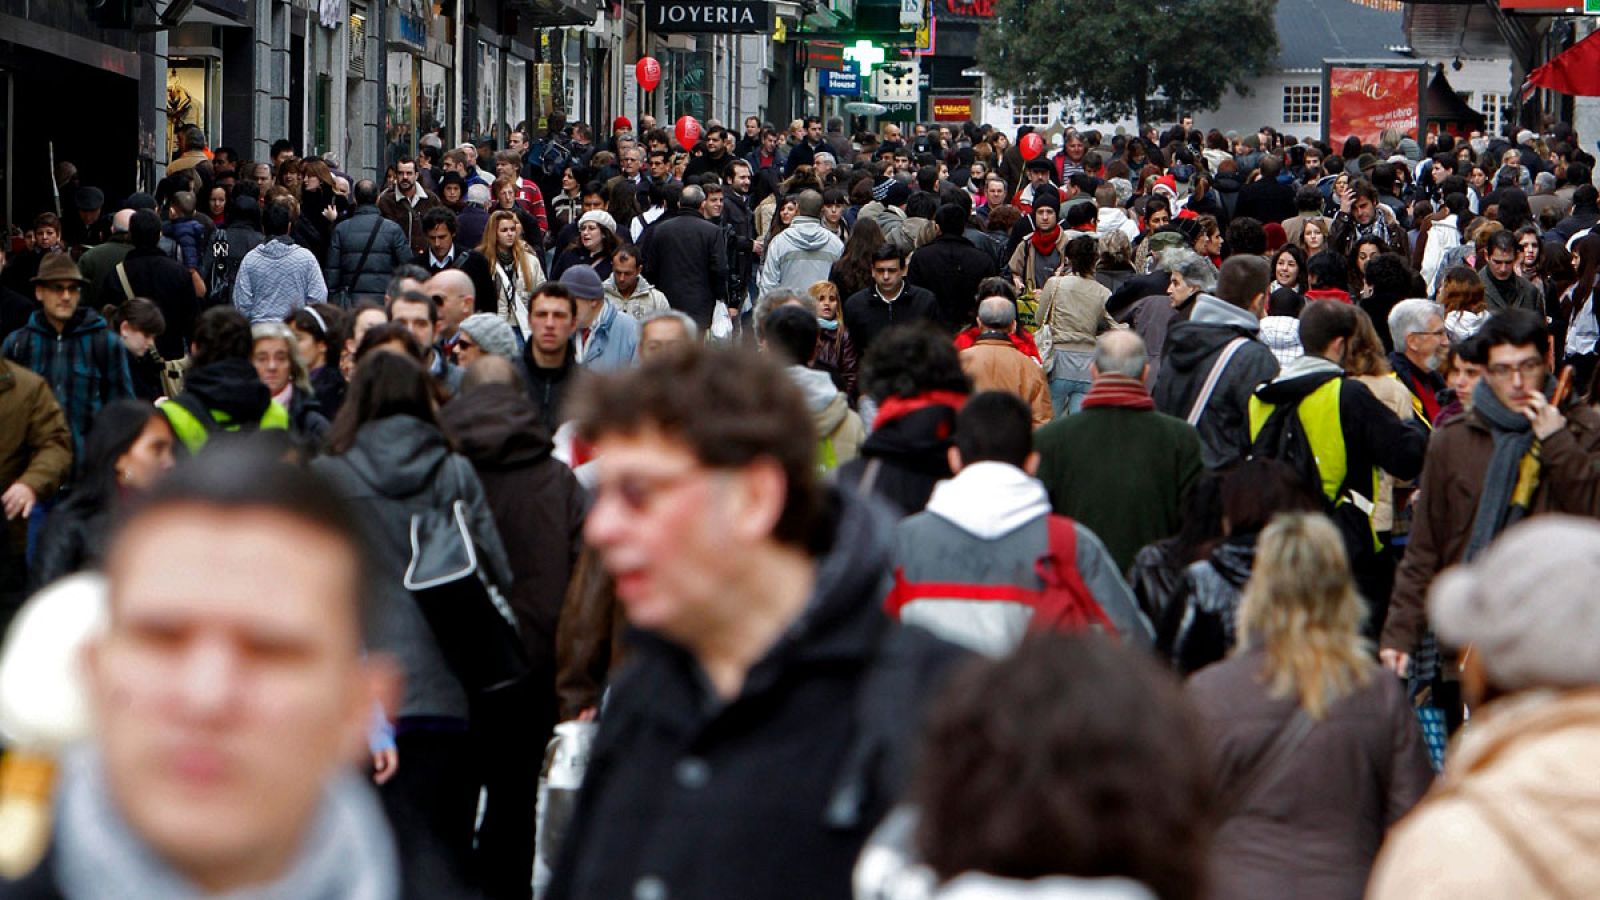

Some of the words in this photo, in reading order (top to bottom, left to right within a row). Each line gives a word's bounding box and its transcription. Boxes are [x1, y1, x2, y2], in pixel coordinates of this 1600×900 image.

[659, 5, 754, 25] JOYERIA
[829, 71, 856, 80] Phone
[829, 80, 856, 88] House
